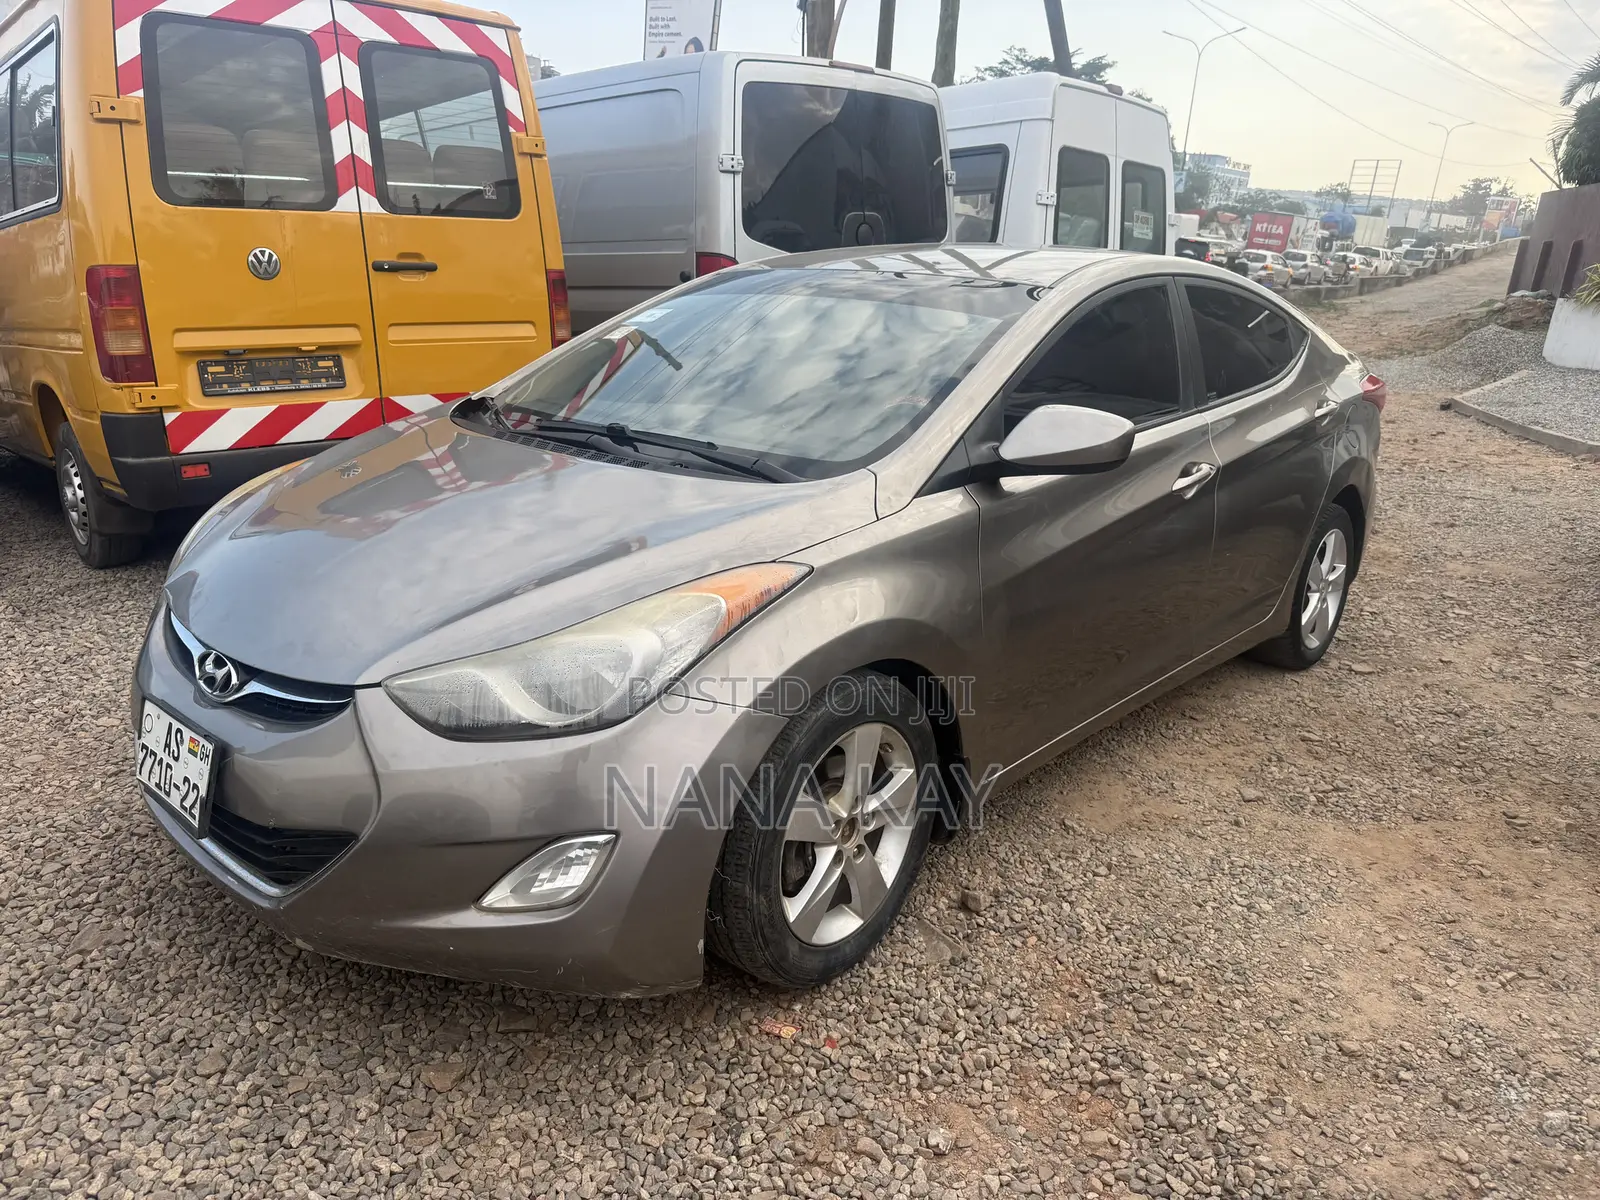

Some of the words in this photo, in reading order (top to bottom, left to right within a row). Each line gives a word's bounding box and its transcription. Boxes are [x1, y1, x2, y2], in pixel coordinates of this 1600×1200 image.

[163, 721, 184, 762] AS
[200, 743, 211, 766] GH
[138, 742, 201, 821] 7710-22
